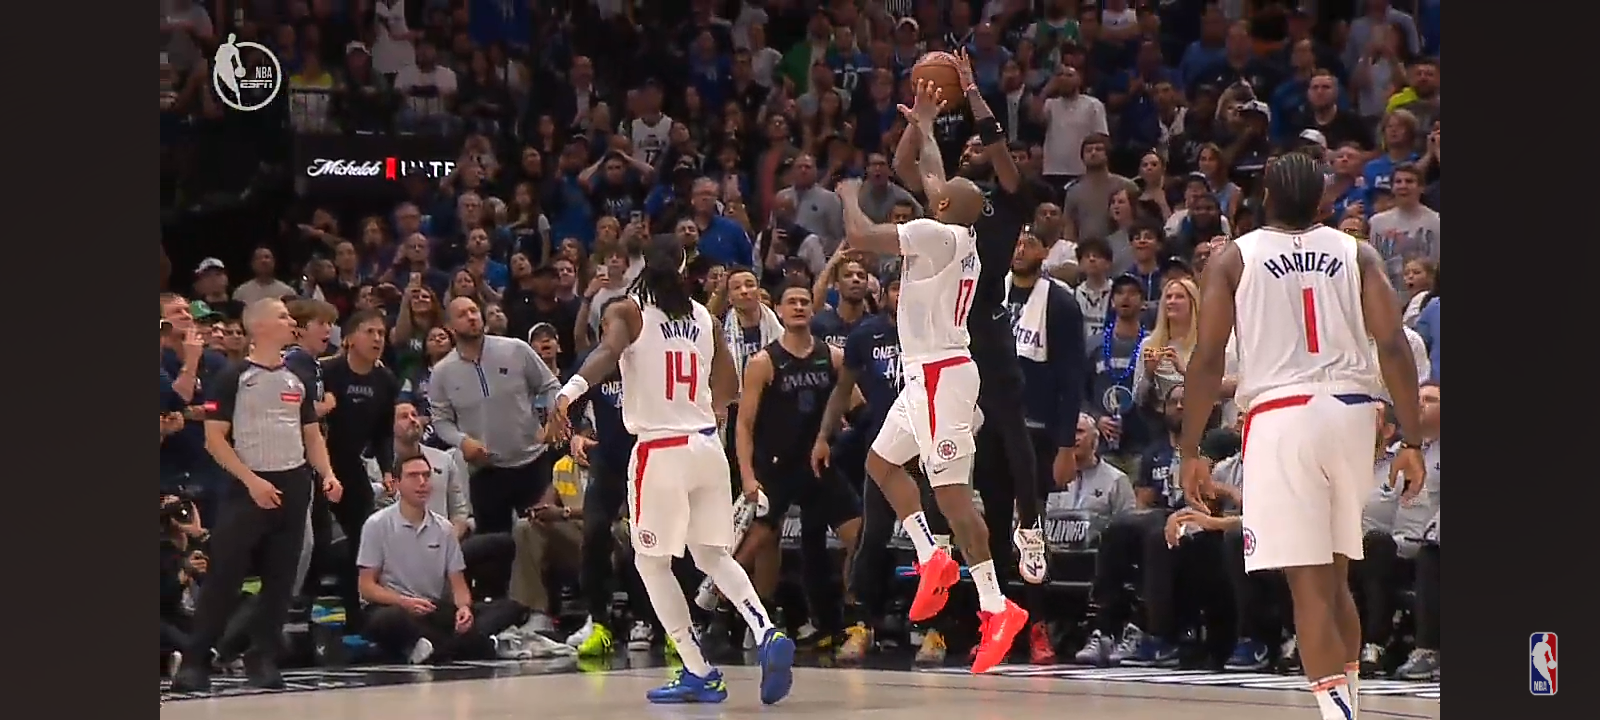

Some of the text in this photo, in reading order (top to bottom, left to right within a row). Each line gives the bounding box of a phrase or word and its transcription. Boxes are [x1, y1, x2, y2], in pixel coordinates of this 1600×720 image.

[307, 158, 382, 177] Michelob
[1263, 252, 1343, 279] HARDEN
[954, 279, 974, 327] 17
[1302, 287, 1319, 354] 1
[660, 320, 700, 343] MANN
[665, 350, 697, 402] 14
